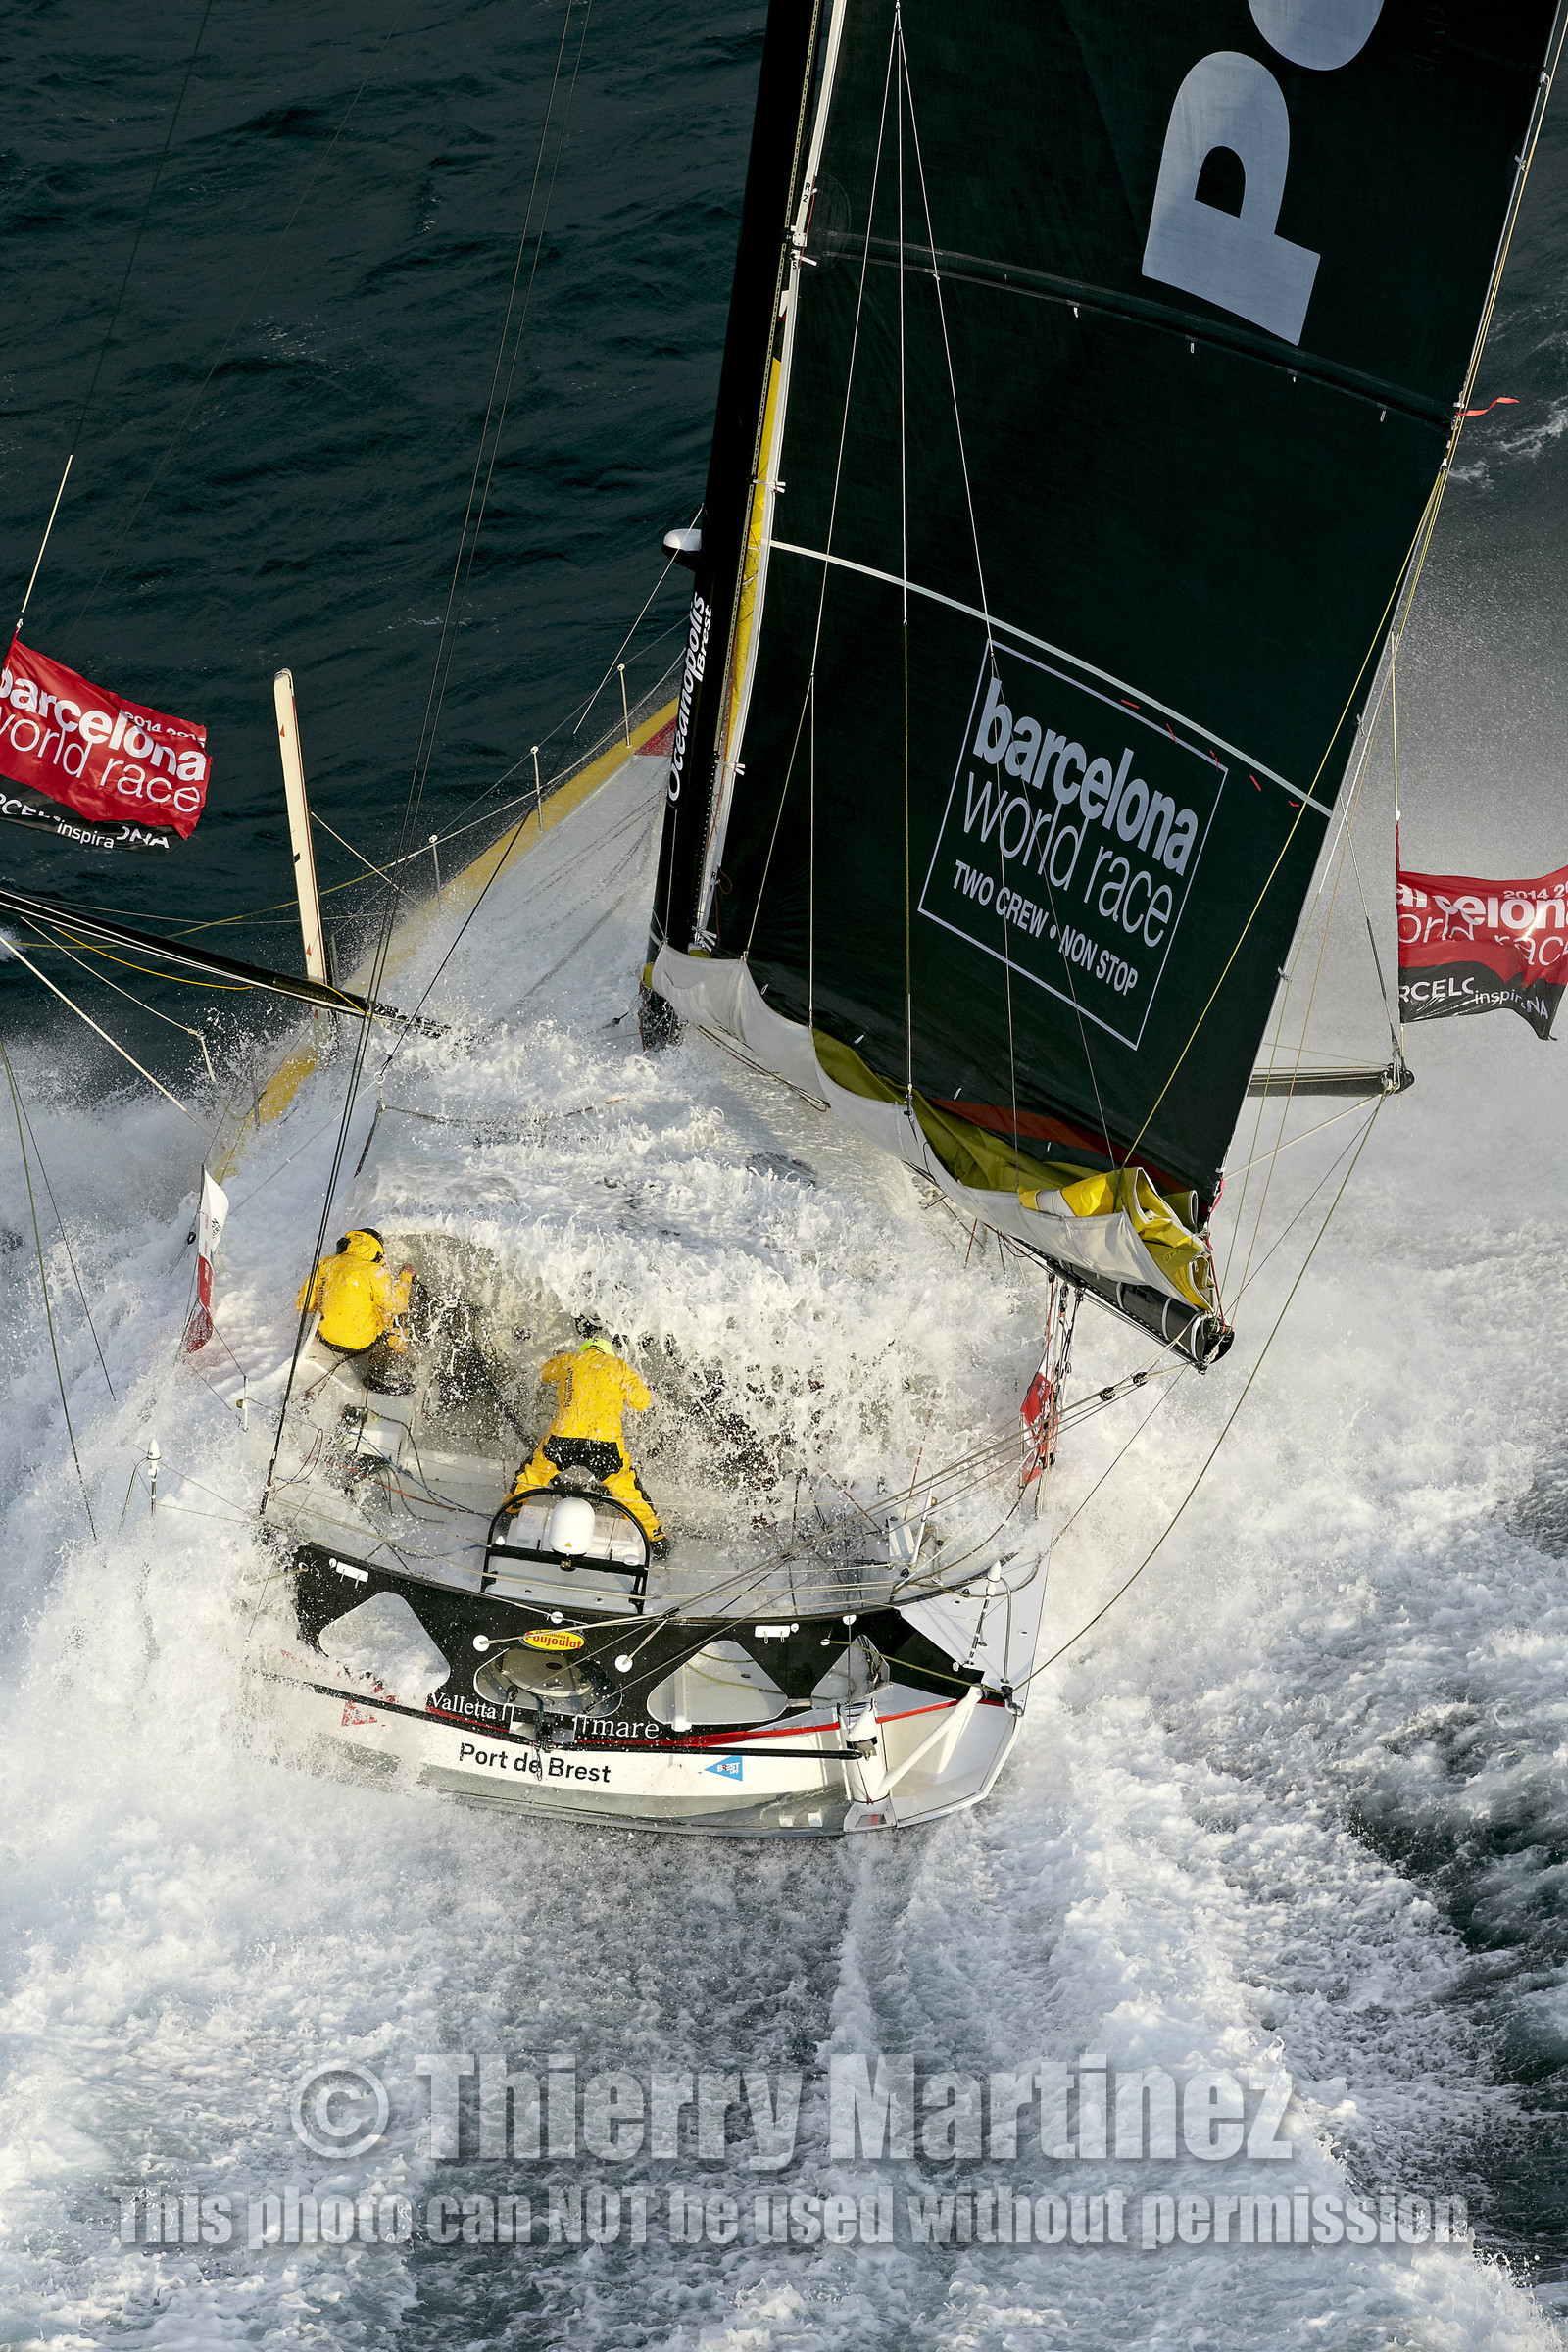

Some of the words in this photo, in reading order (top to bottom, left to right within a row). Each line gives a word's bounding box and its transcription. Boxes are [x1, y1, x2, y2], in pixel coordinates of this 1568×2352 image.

[697, 604, 712, 675] Brest
[668, 591, 705, 802] Oceanopolis
[100, 758, 201, 813] race
[973, 676, 1199, 877] barcelona
[57, 819, 115, 849] inspira
[963, 771, 1091, 892] world
[1084, 844, 1173, 948] race
[951, 859, 994, 906] TWO
[996, 886, 1050, 939] CREW
[1058, 929, 1097, 971] NON
[1096, 950, 1139, 996] STOP
[430, 1691, 498, 1721] Valletta
[459, 1741, 508, 1770] Port
[514, 1752, 540, 1774] de
[548, 1756, 612, 1784] Brest
